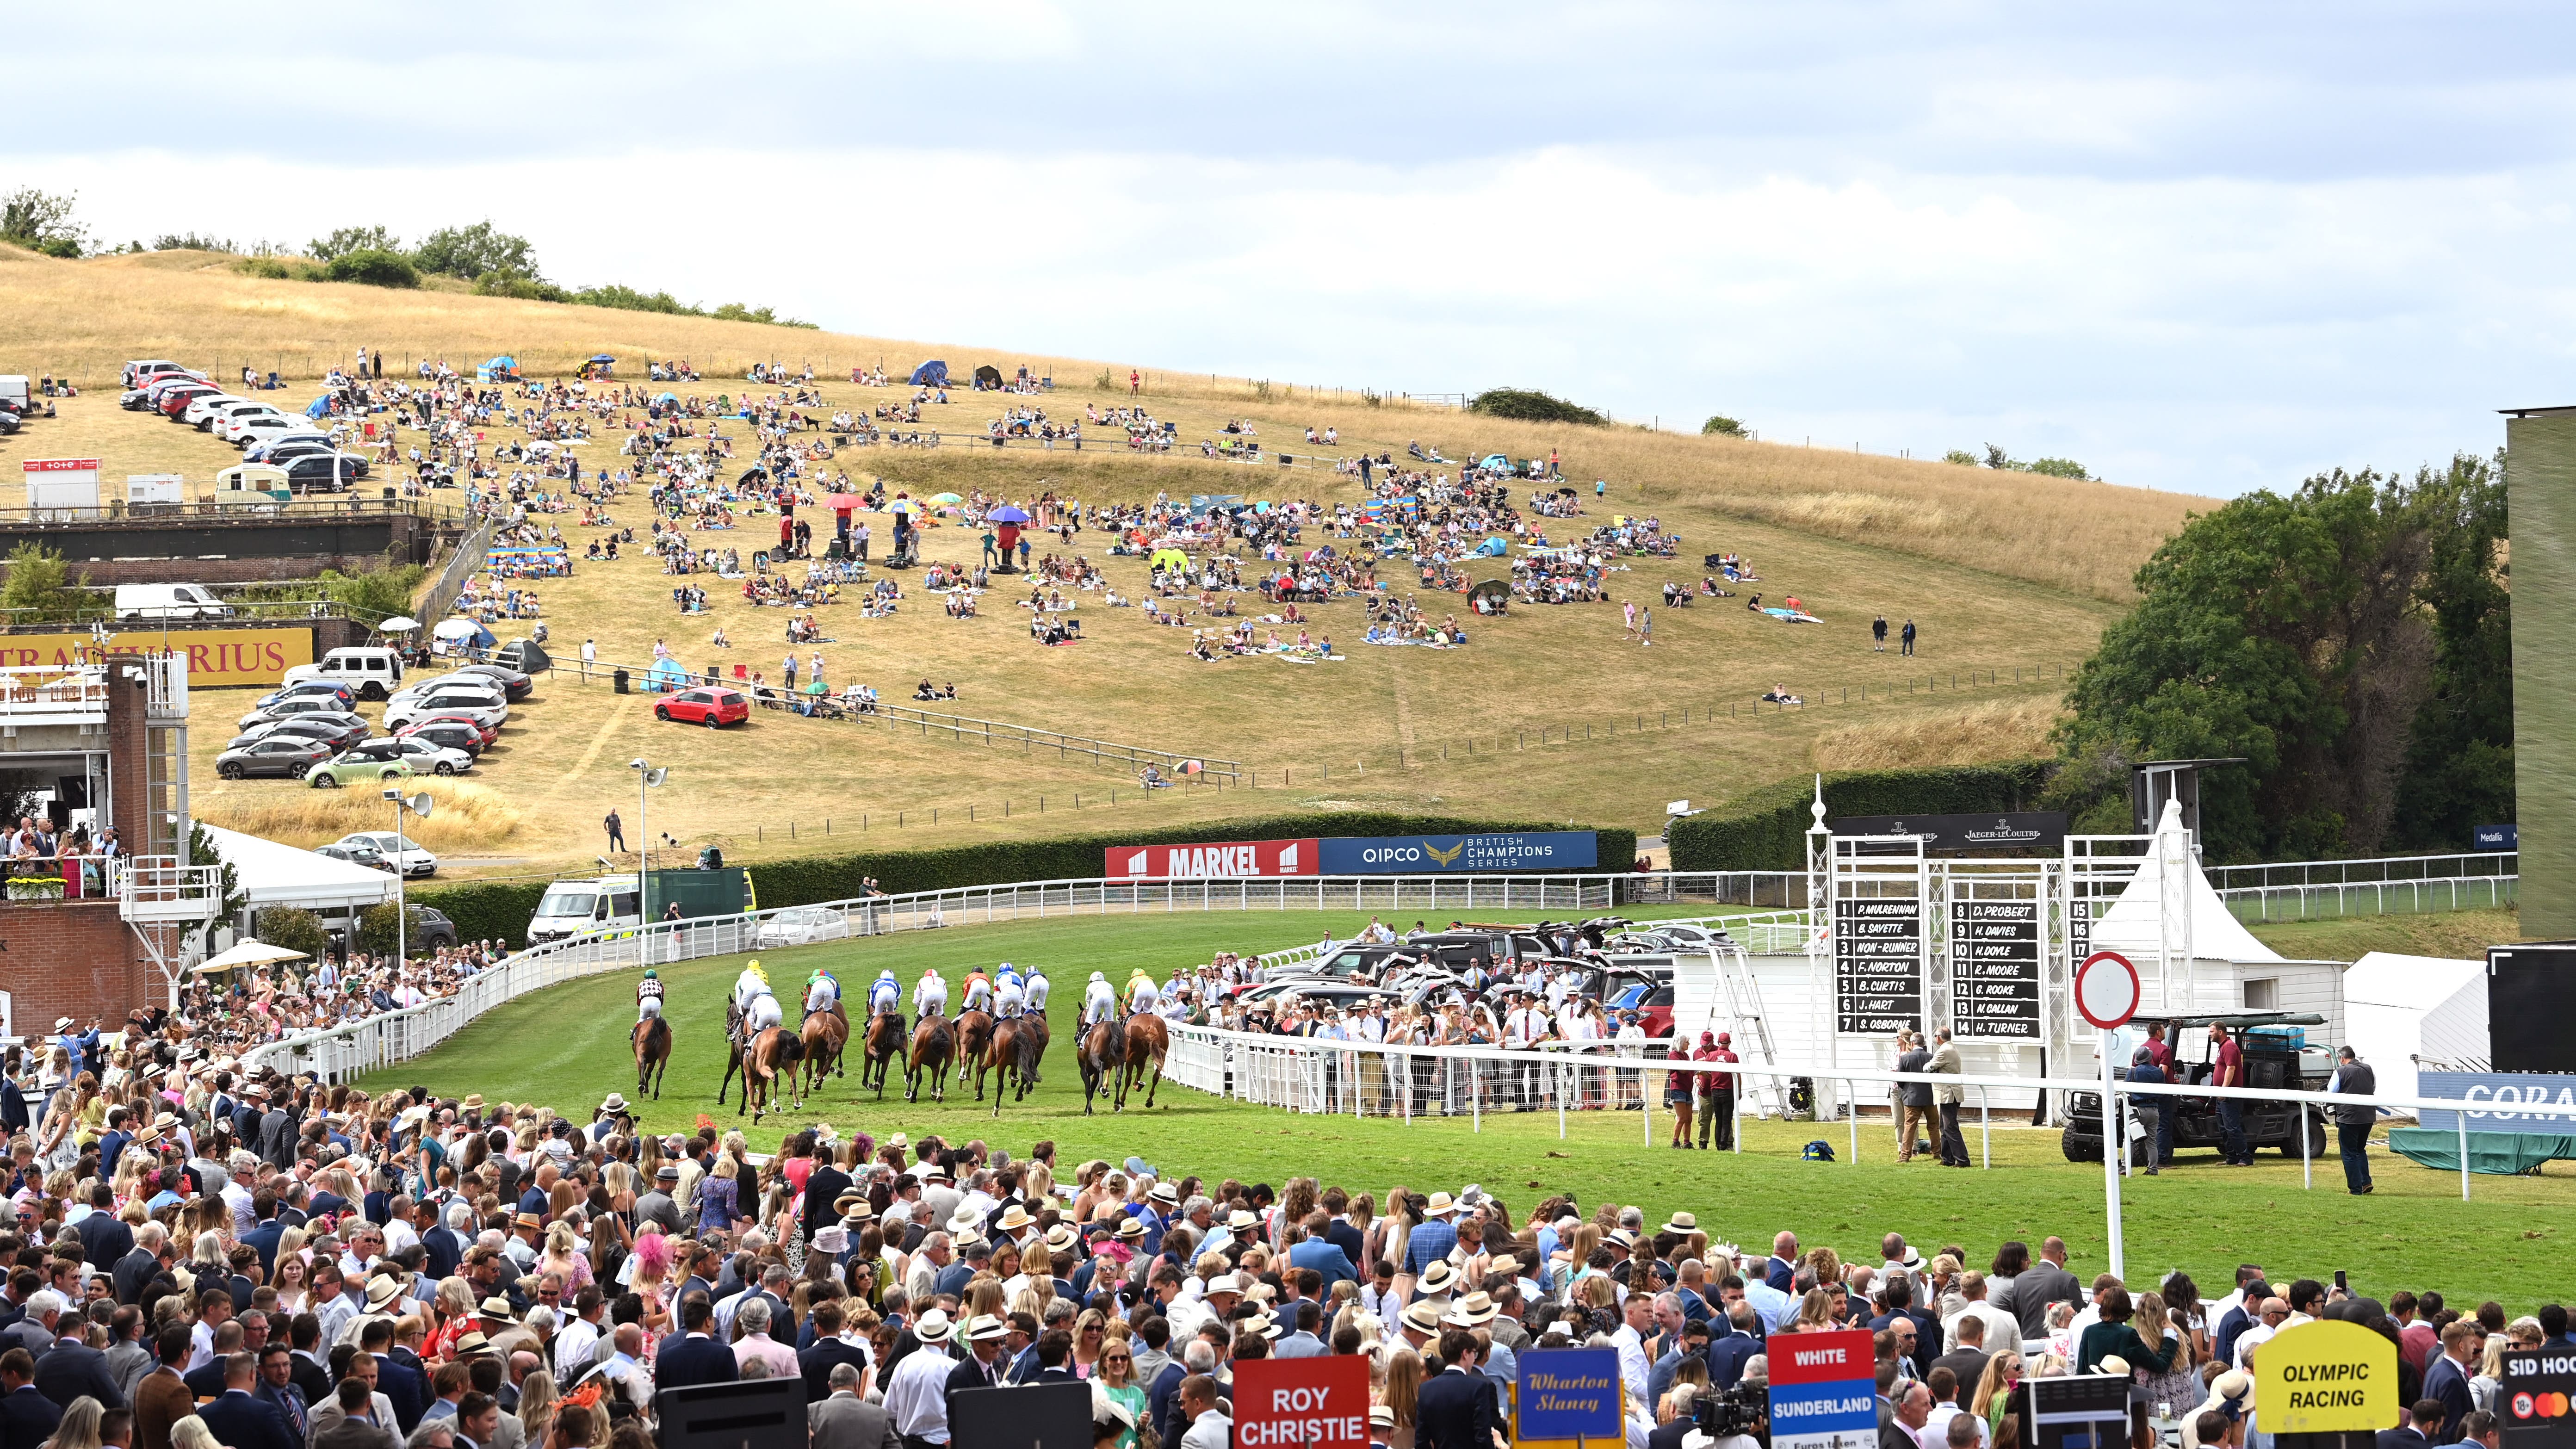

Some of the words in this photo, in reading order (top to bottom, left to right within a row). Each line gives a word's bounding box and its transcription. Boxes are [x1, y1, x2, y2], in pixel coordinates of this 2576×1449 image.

[1468, 837, 1523, 846] BRITISH
[2480, 832, 2502, 842] Medallia
[1363, 848, 1420, 863] QIPCO
[1468, 846, 1552, 858] CHAMPIONS
[1168, 846, 1259, 876] MARKEL
[1468, 858, 1517, 867] SERIES
[1842, 904, 1846, 915] 1
[1957, 905, 1964, 917] 8
[2074, 904, 2086, 916] 15
[1841, 922, 1849, 935] 2
[1957, 925, 1965, 937] 9
[2074, 923, 2086, 936] 16
[1841, 941, 1848, 954] 3
[1857, 941, 1917, 953] NON-RUNNER
[1956, 944, 1967, 956] 10
[2075, 943, 2087, 955] 17
[1840, 961, 1849, 972] 4
[1957, 963, 1966, 976] 11
[1842, 980, 1849, 992] 5
[1957, 983, 1969, 995] 12
[1843, 999, 1851, 1011] 6
[1957, 1002, 1969, 1015] 13
[1843, 1018, 1851, 1030] 7
[1957, 1021, 1969, 1034] 14
[2465, 1085, 2576, 1121] CORA
[1795, 1348, 1846, 1367] WHITE
[2283, 1363, 2369, 1382] OLYMPIC
[2508, 1358, 2538, 1376] SID
[1528, 1373, 1609, 1390] Wharton
[1273, 1387, 1330, 1412] ROY
[1536, 1393, 1599, 1413] Slaney
[2290, 1390, 2364, 1408] RACING
[1774, 1396, 1872, 1418] SUNDERLAND
[1240, 1416, 1363, 1446] CHRISTIE
